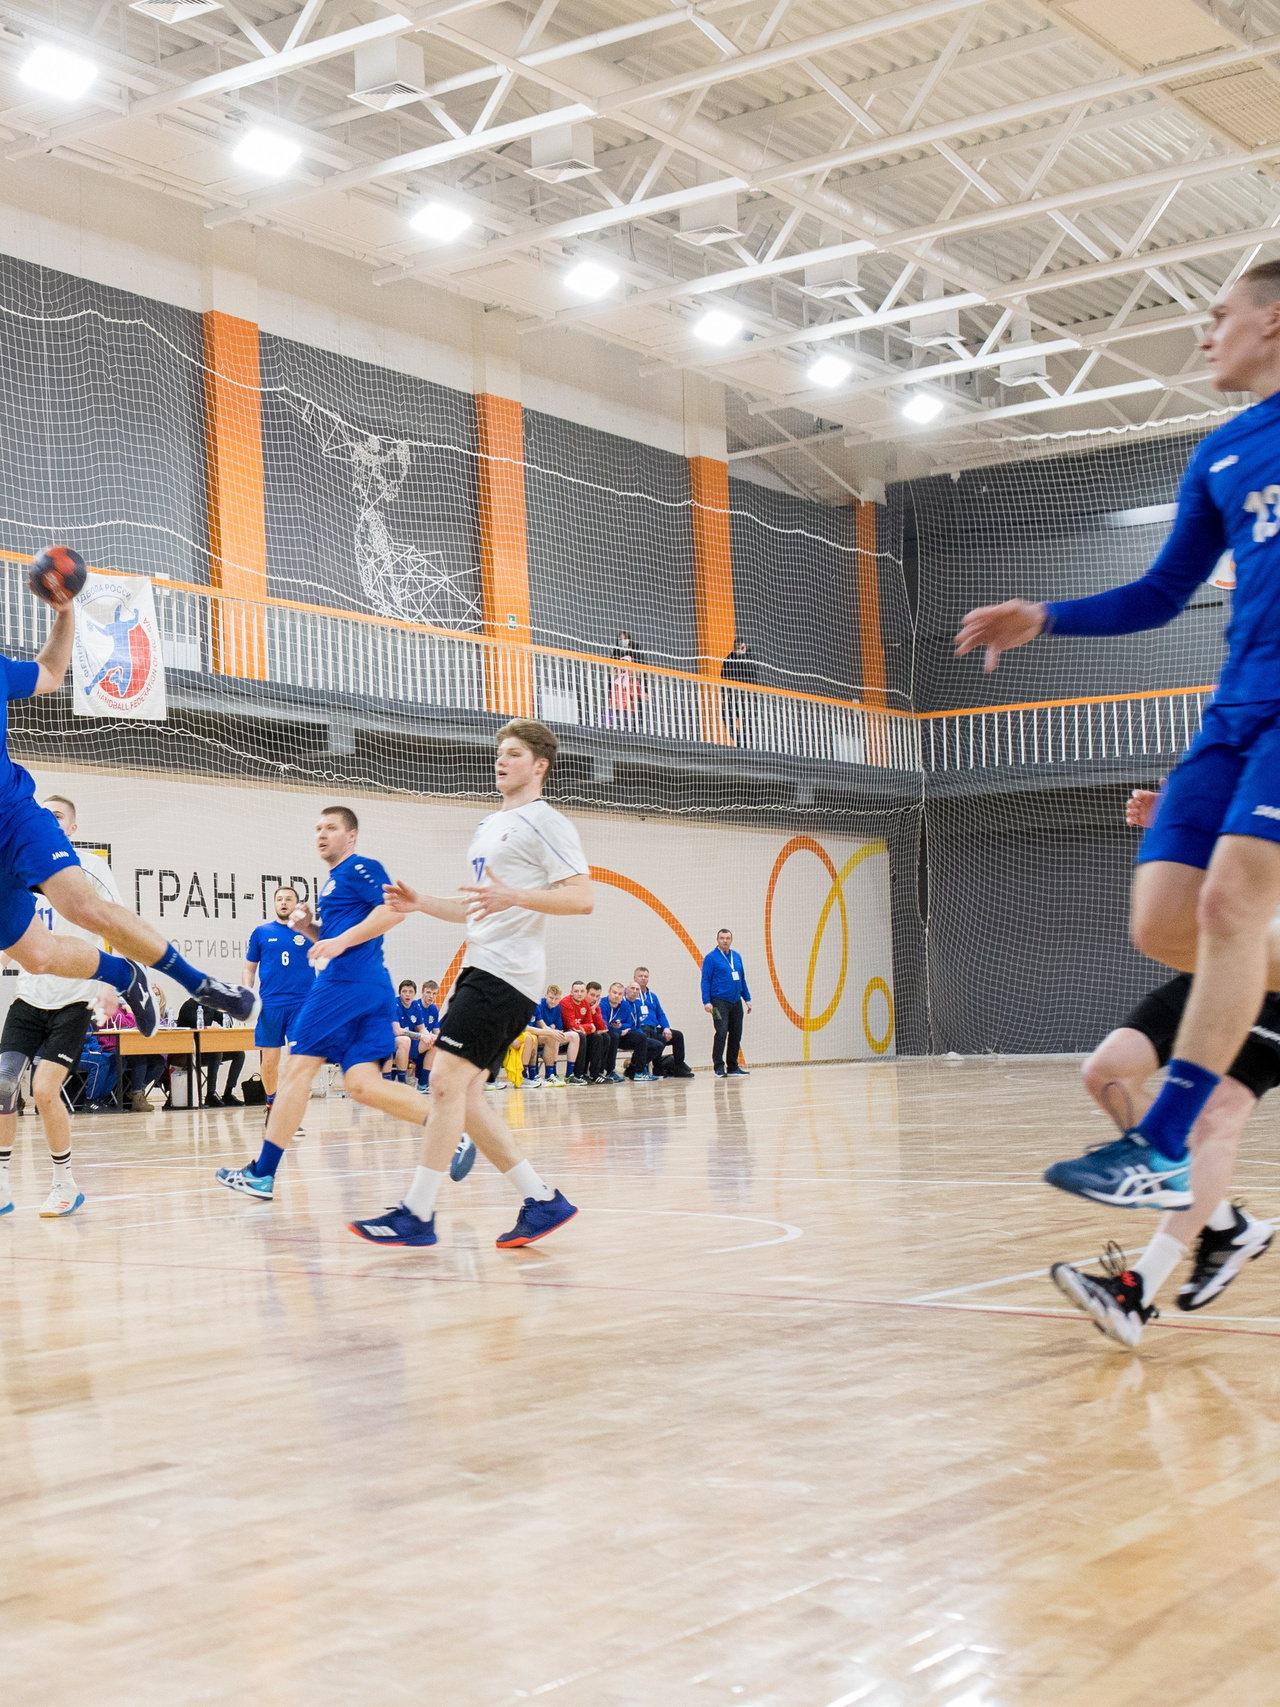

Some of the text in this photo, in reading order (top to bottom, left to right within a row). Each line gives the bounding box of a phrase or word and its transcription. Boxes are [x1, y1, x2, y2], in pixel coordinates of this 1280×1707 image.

[96, 689, 130, 711] HANDBALL
[130, 669, 158, 710] FEDERATION
[472, 857, 486, 883] 17
[37, 907, 53, 931] 11
[281, 951, 290, 966] 6
